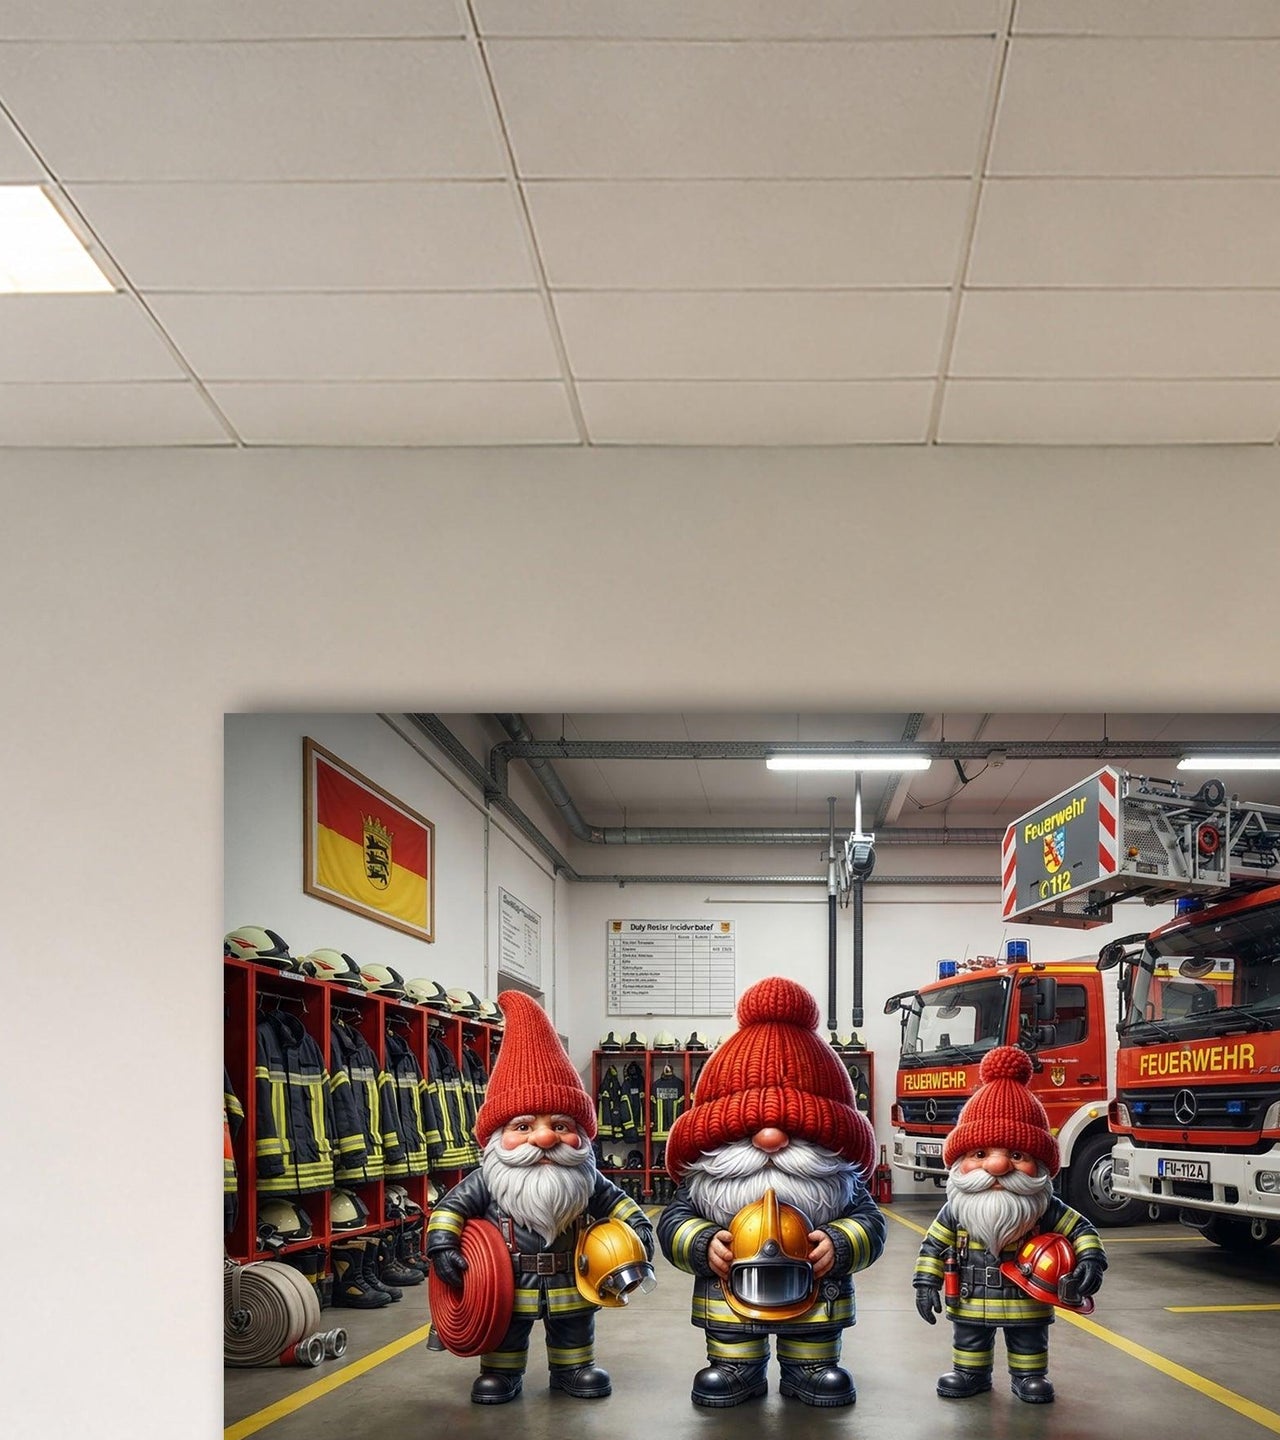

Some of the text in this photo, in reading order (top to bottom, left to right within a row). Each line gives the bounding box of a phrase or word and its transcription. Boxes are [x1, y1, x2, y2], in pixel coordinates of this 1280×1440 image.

[1024, 797, 1087, 844] Feuerwehr
[1050, 870, 1072, 895] 112
[1140, 1043, 1255, 1076] FEUERWEHR
[903, 1071, 966, 1091] FEUERWEHR
